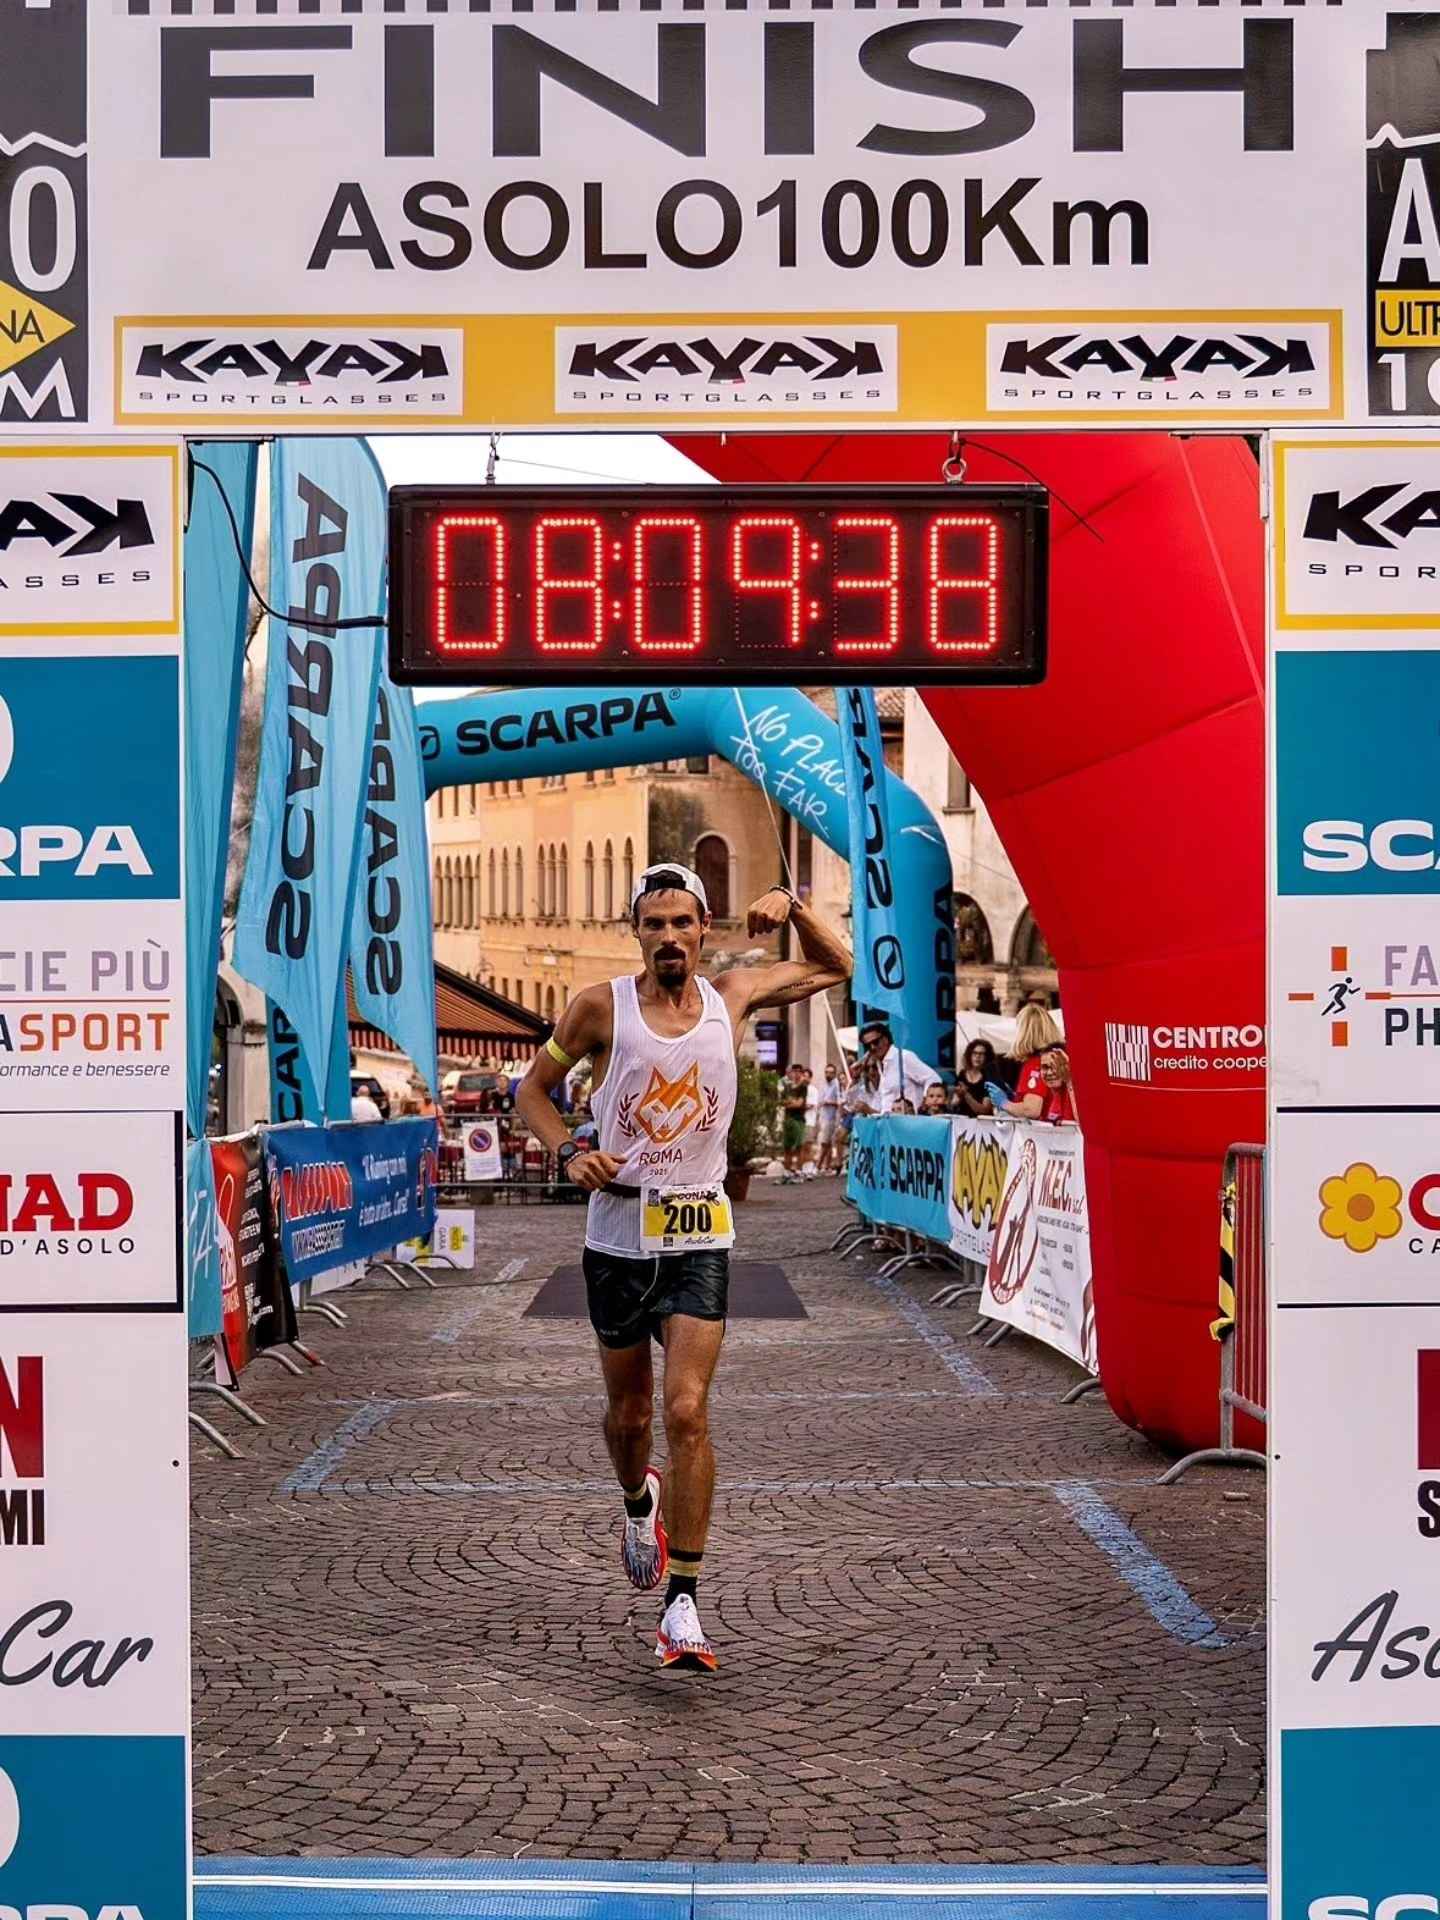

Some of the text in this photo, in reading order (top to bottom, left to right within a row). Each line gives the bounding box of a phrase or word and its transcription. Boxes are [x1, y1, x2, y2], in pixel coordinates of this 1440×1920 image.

[160, 18, 1294, 158] FINISH
[306, 176, 1150, 271] ASOLO100Km
[136, 338, 449, 384] KAYAK
[569, 336, 884, 382] KAYAK
[1000, 335, 1315, 380] KAYAK
[139, 391, 446, 405] SPORTGLASSES
[573, 390, 880, 403] SPORTGLASSES
[1004, 387, 1312, 400] SPORTGLASSES
[436, 515, 1000, 653] 08:09:38
[1302, 819, 1440, 872] SC
[91, 938, 169, 992] PIÙ
[72, 1066, 82, 1077] e
[86, 1062, 170, 1077] benessere
[1154, 1056, 1208, 1070] credito
[639, 1148, 682, 1169] ROMA
[890, 1145, 945, 1204] SCARPA
[664, 1203, 712, 1235] 200
[0, 1238, 134, 1255] D'ASOLO
[0, 1599, 154, 1688] Car
